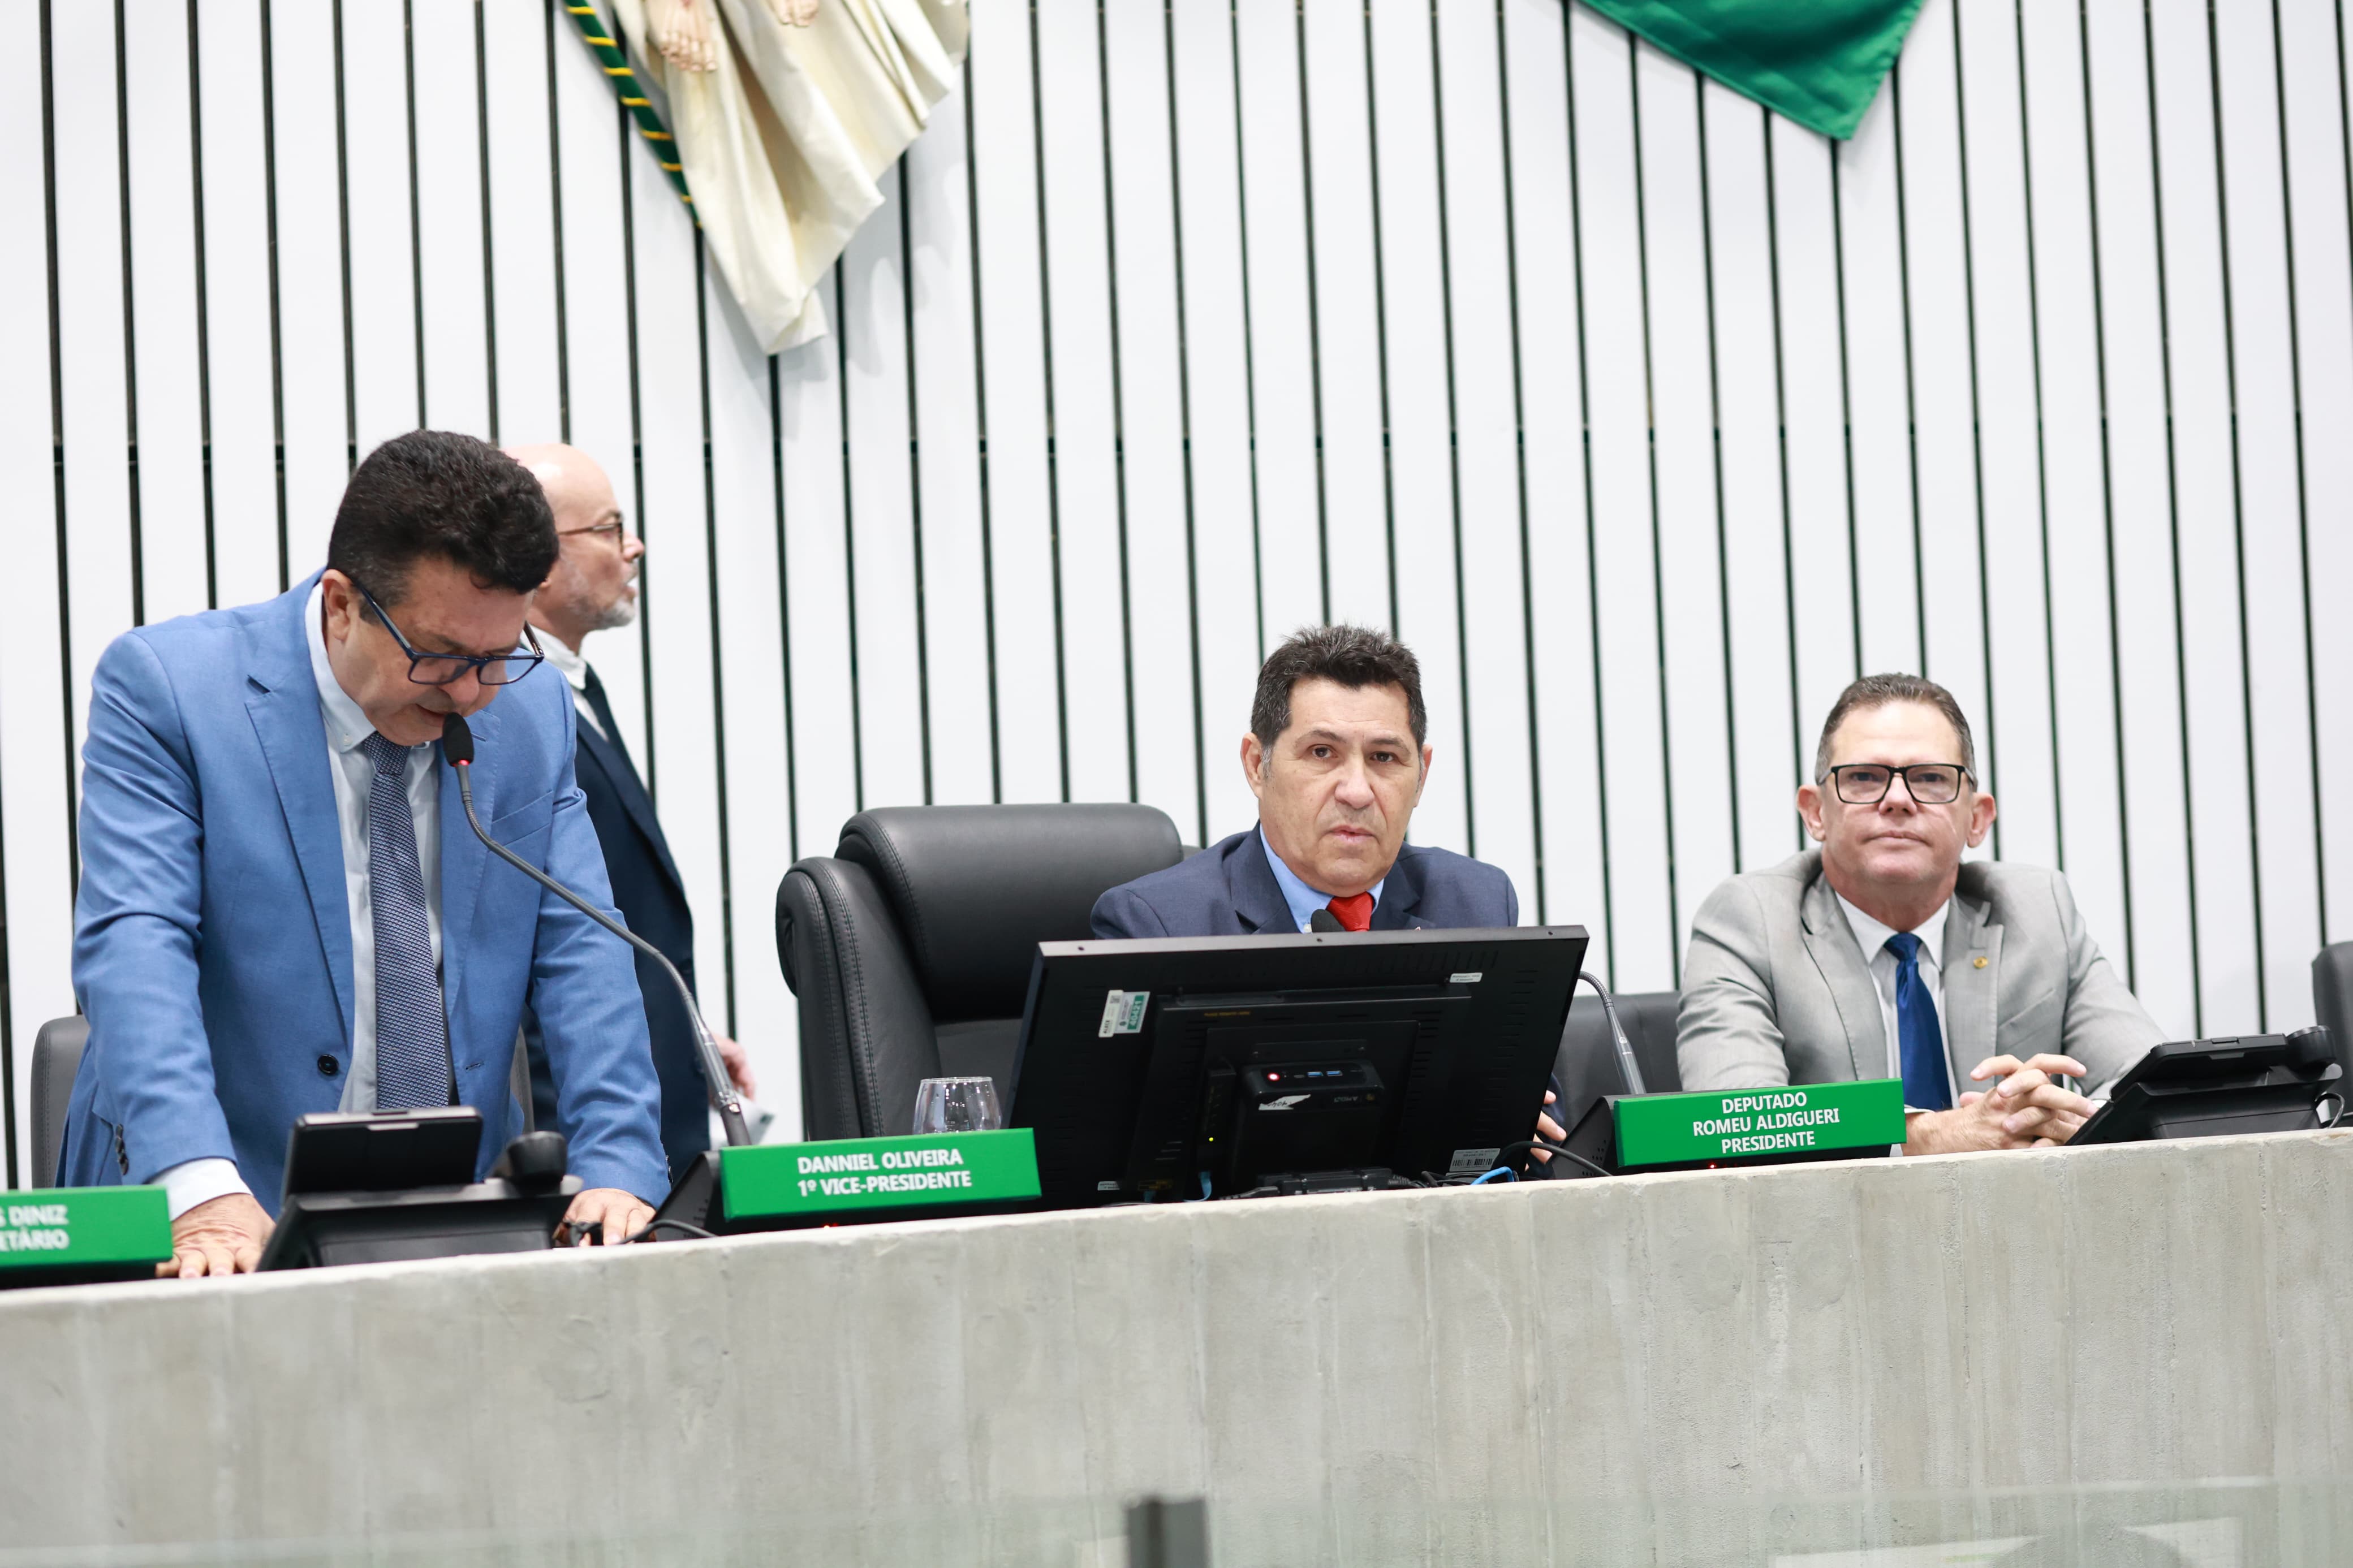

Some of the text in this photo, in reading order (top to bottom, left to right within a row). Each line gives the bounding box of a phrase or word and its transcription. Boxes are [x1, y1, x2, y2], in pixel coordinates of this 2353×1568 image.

[1722, 1092, 1807, 1114] DEPUTADO
[1693, 1108, 1840, 1137] ROMEU ALDIGUERI
[1721, 1131, 1816, 1154] PRESIDENTE
[797, 1148, 964, 1174] DANNIEL OLIVEIRA
[798, 1170, 972, 1196] 1º VICE-PRESIDENTE
[8, 1205, 70, 1226] DINIZ
